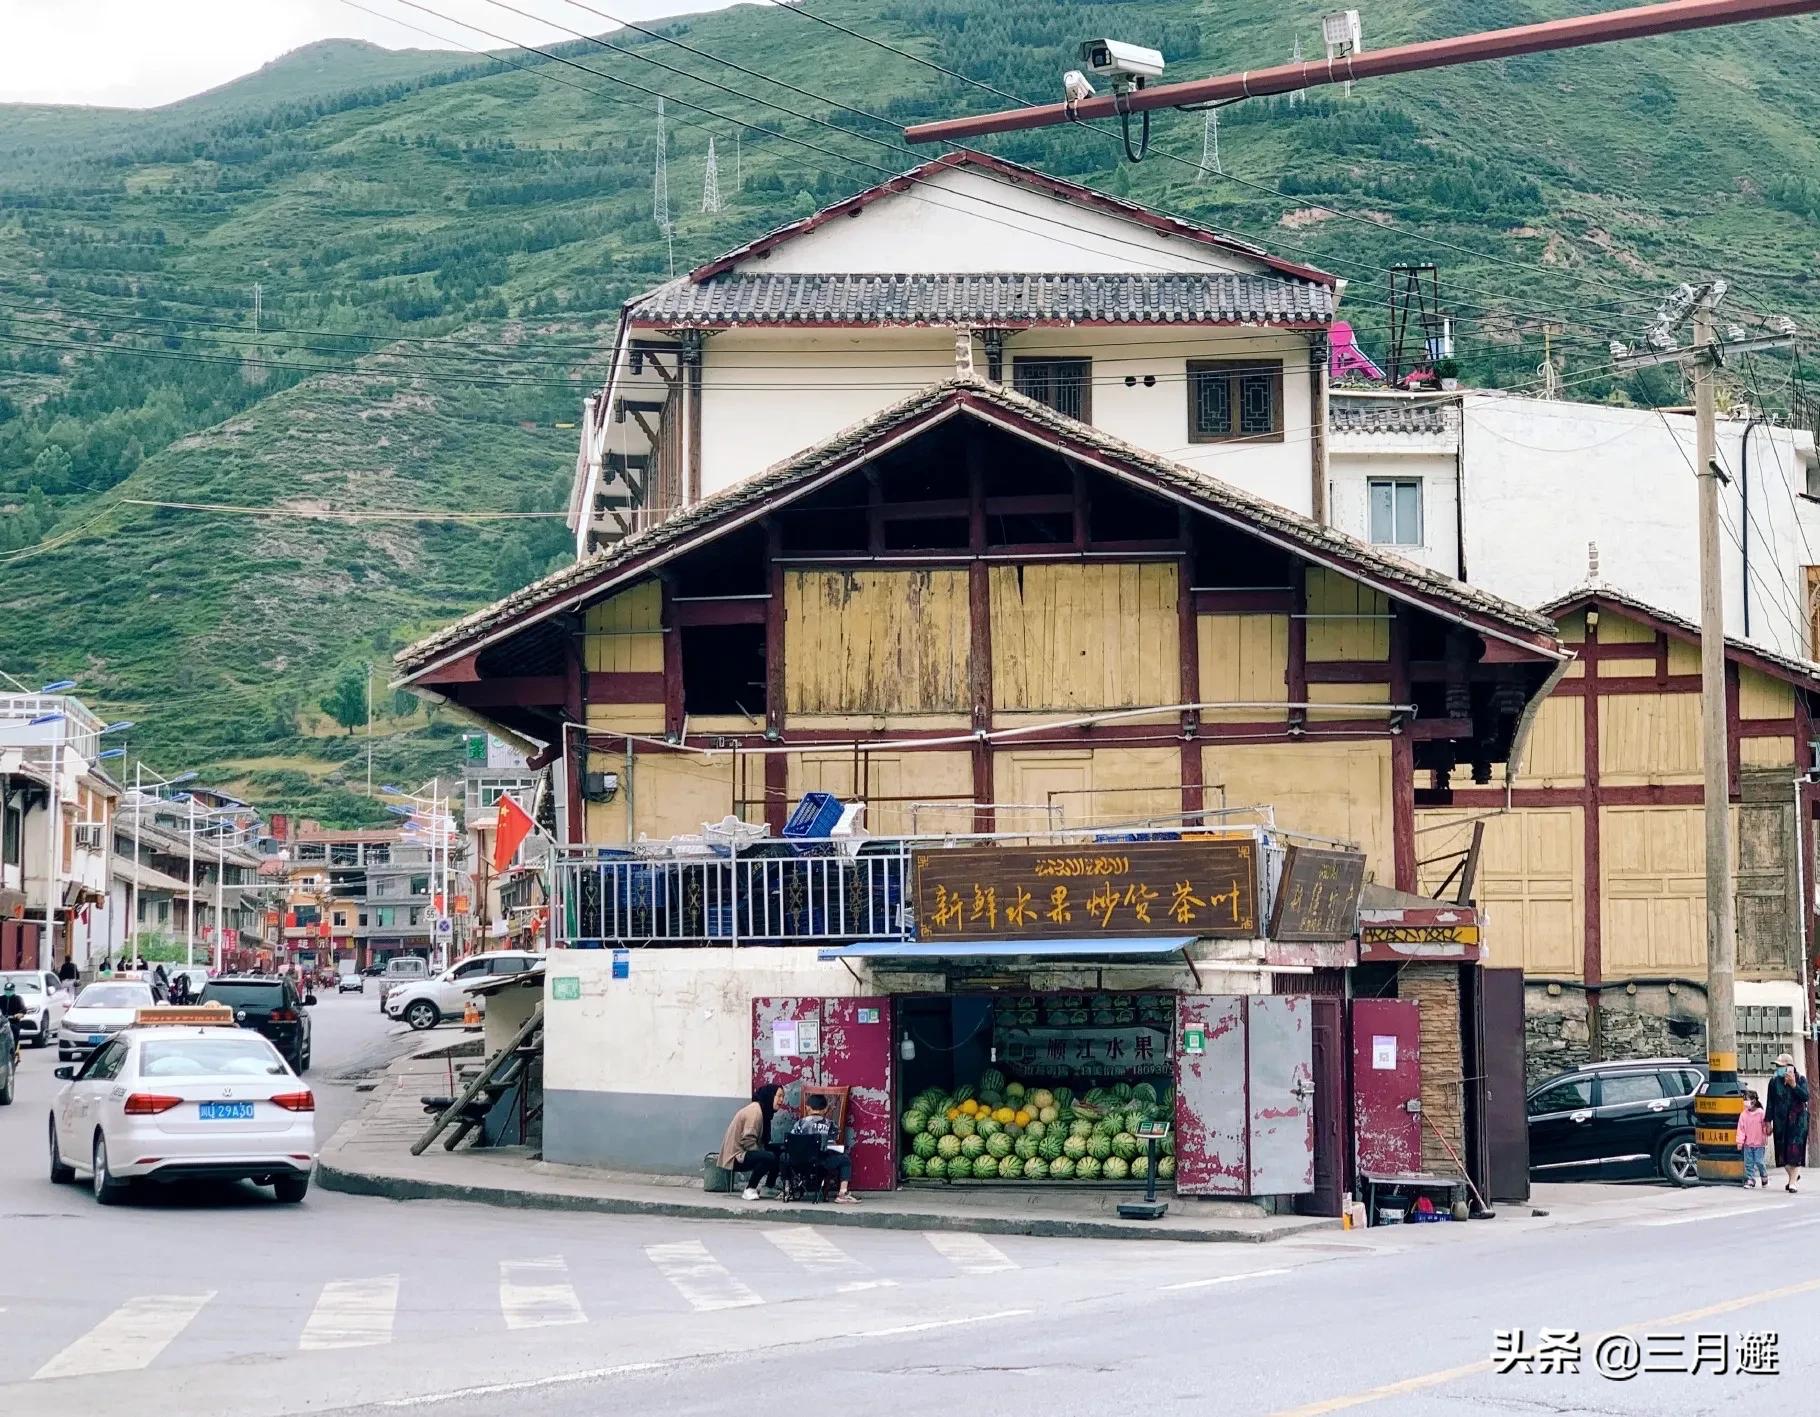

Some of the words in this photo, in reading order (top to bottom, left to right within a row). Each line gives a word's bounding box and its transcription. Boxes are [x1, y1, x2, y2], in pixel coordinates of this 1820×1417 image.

[931, 880, 1240, 931] 新鲜水果炒货茶叶
